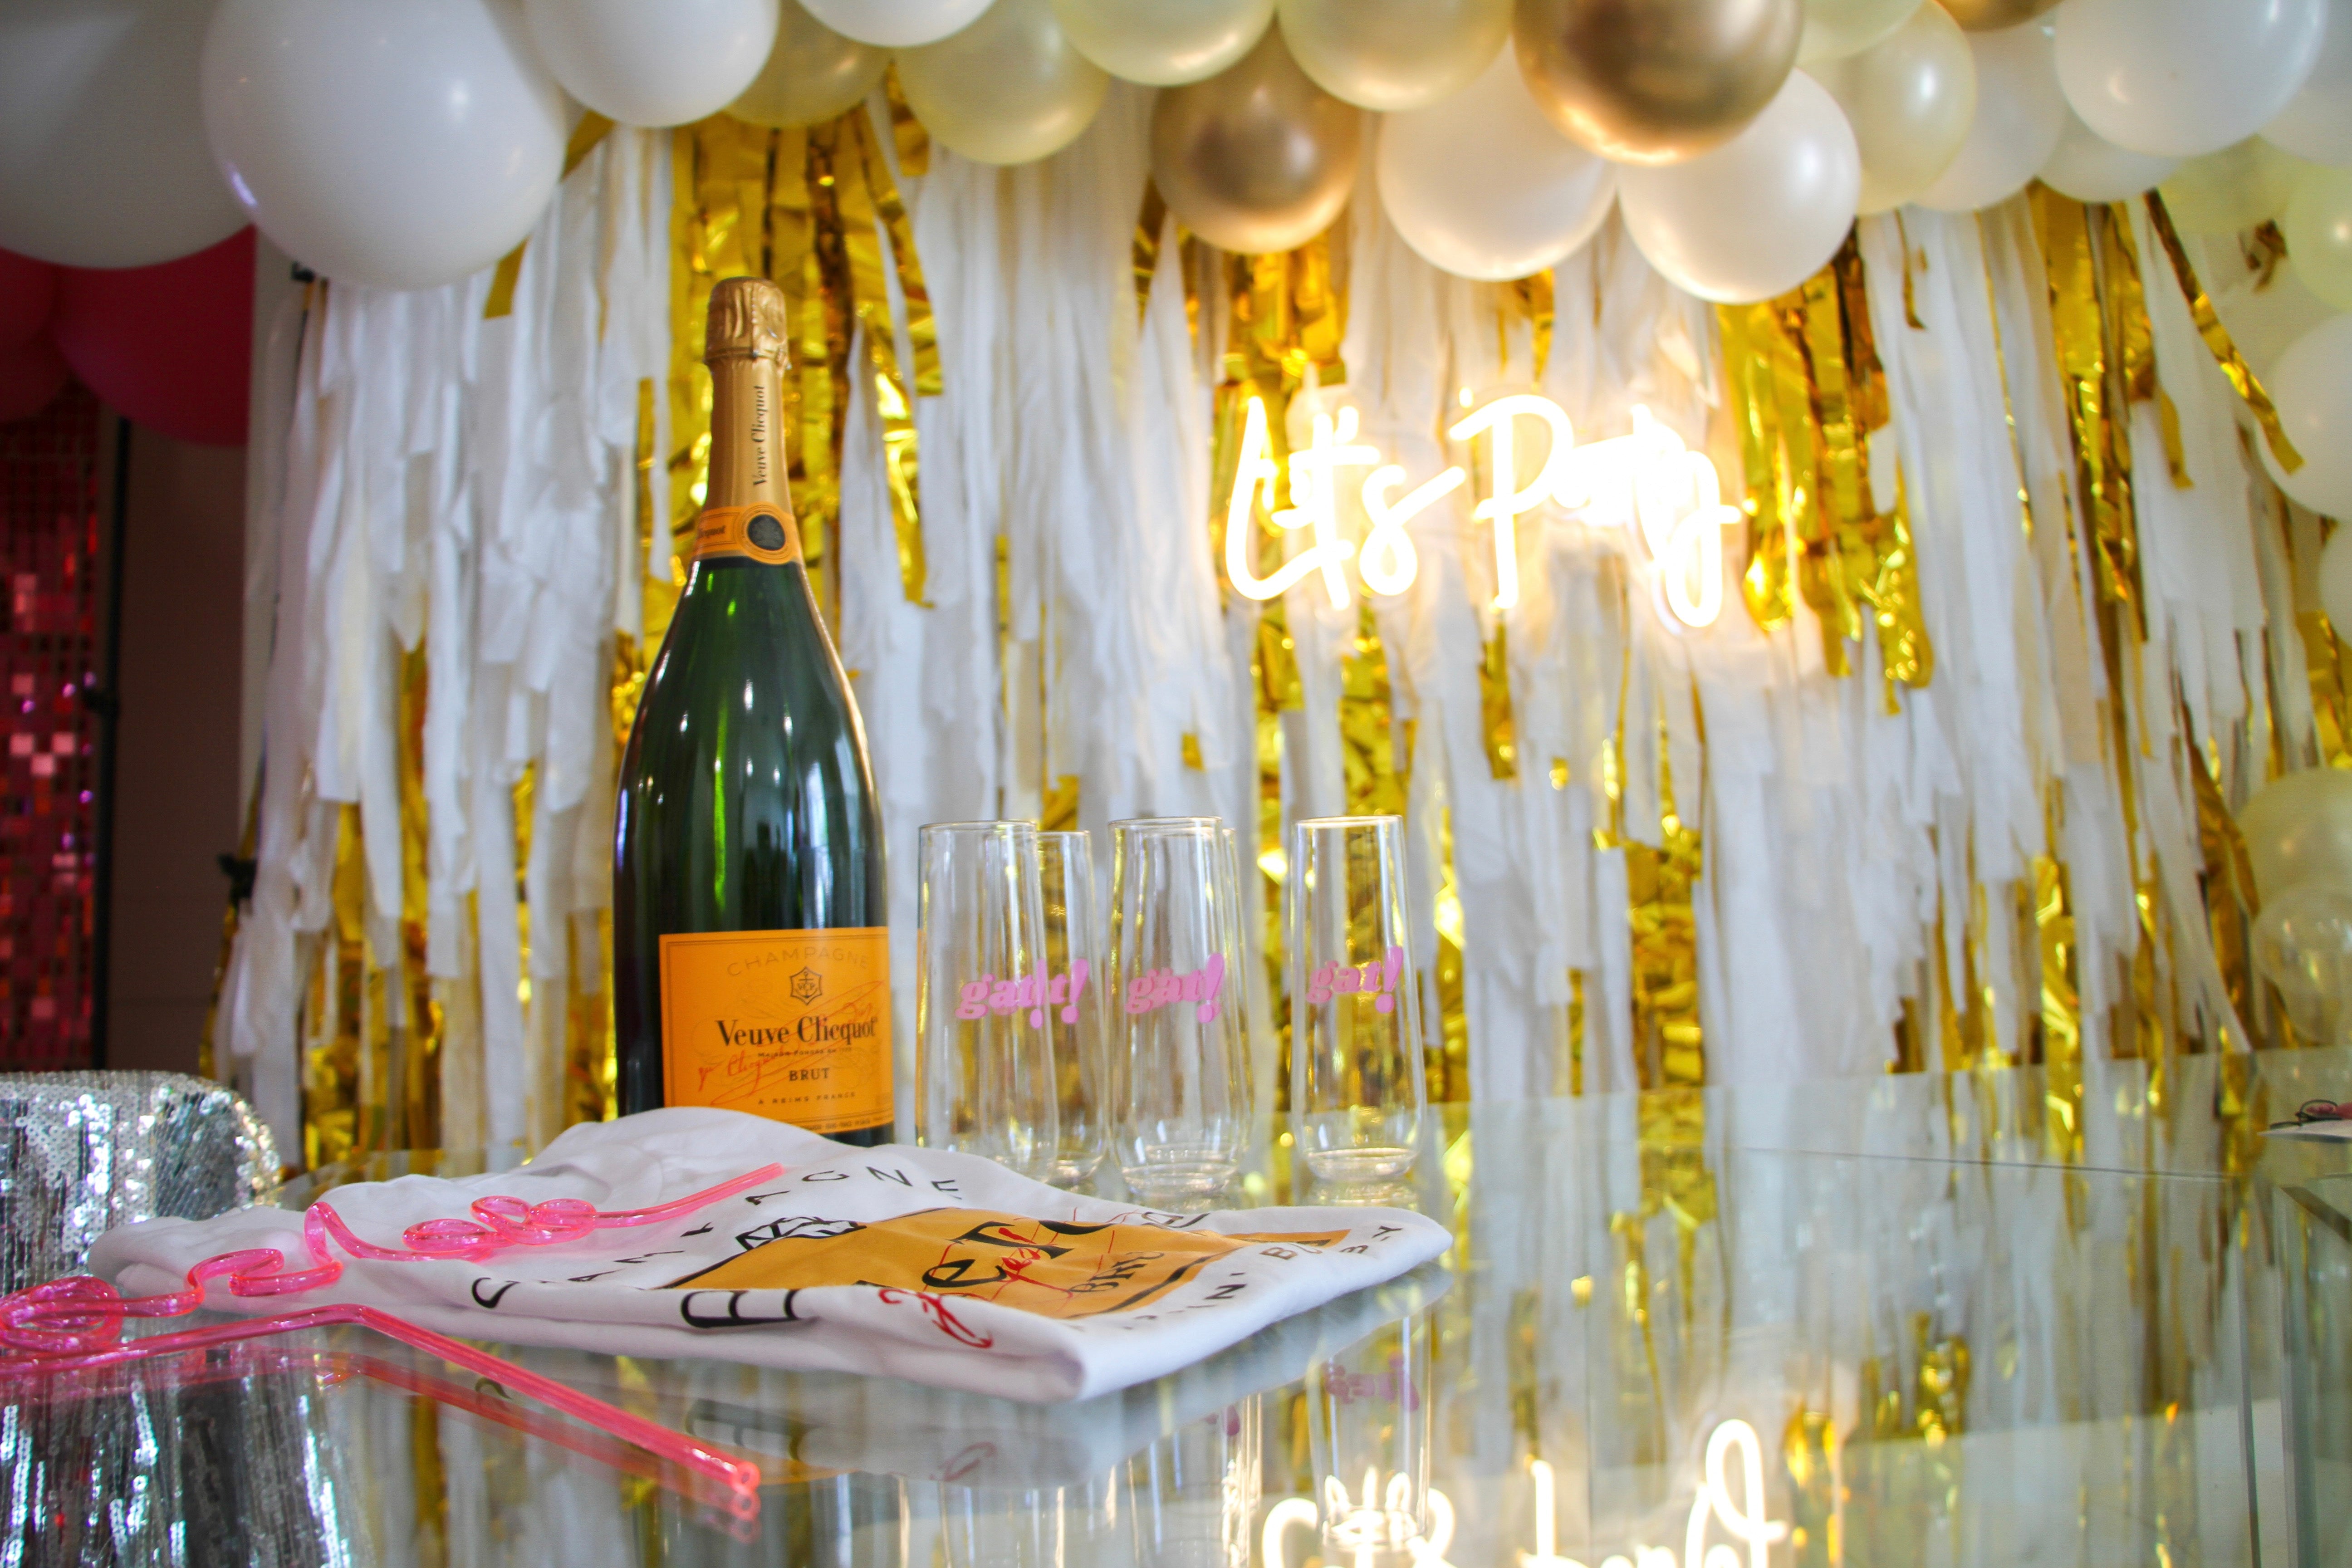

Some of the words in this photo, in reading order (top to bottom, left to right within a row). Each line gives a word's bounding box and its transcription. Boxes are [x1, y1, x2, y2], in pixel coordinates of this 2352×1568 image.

[751, 386, 768, 442] Clicquot
[753, 447, 767, 485] Veuve
[1225, 395, 1467, 610] Let's
[727, 946, 868, 976] CHAMPAGNE
[716, 1019, 790, 1047] Veuve
[797, 1016, 877, 1045] Clicquot
[789, 1067, 830, 1082] BRUT
[772, 1096, 809, 1104] REIMS
[816, 1091, 856, 1100] FRANCE
